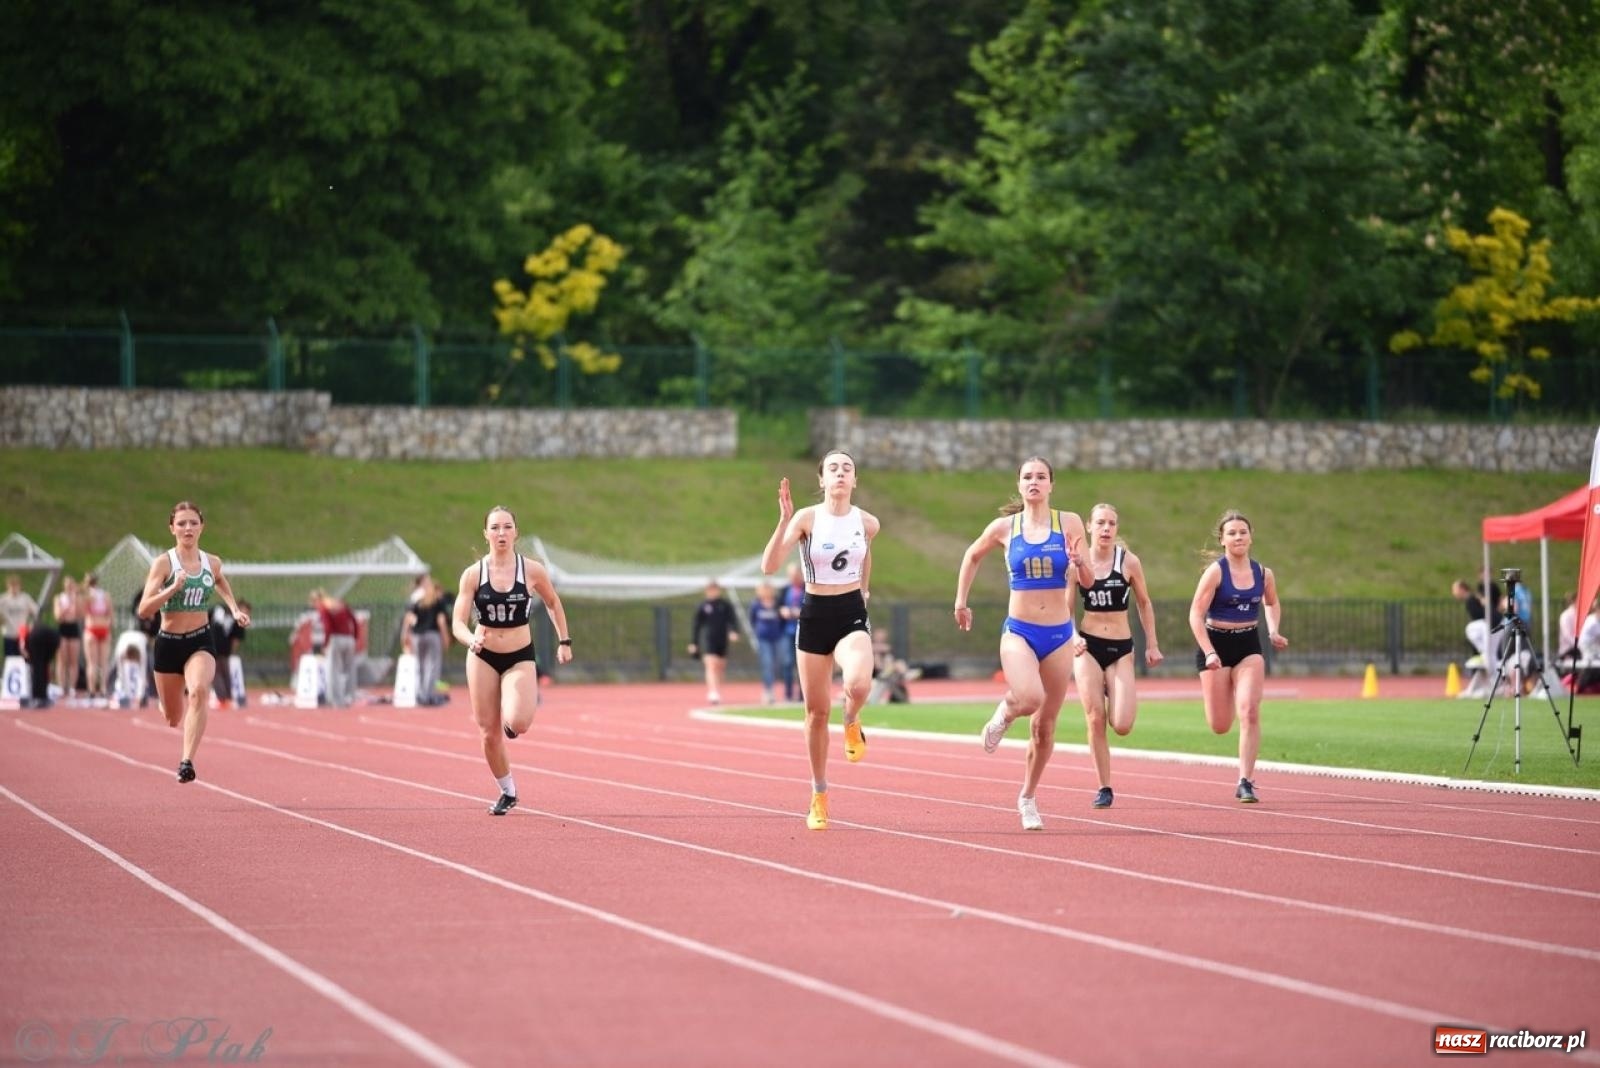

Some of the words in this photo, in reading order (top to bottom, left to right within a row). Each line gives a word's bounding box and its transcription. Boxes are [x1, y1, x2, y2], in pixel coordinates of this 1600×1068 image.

[831, 549, 849, 571] 6
[183, 587, 204, 606] 110
[1088, 590, 1113, 606] 301
[7, 668, 21, 695] 6
